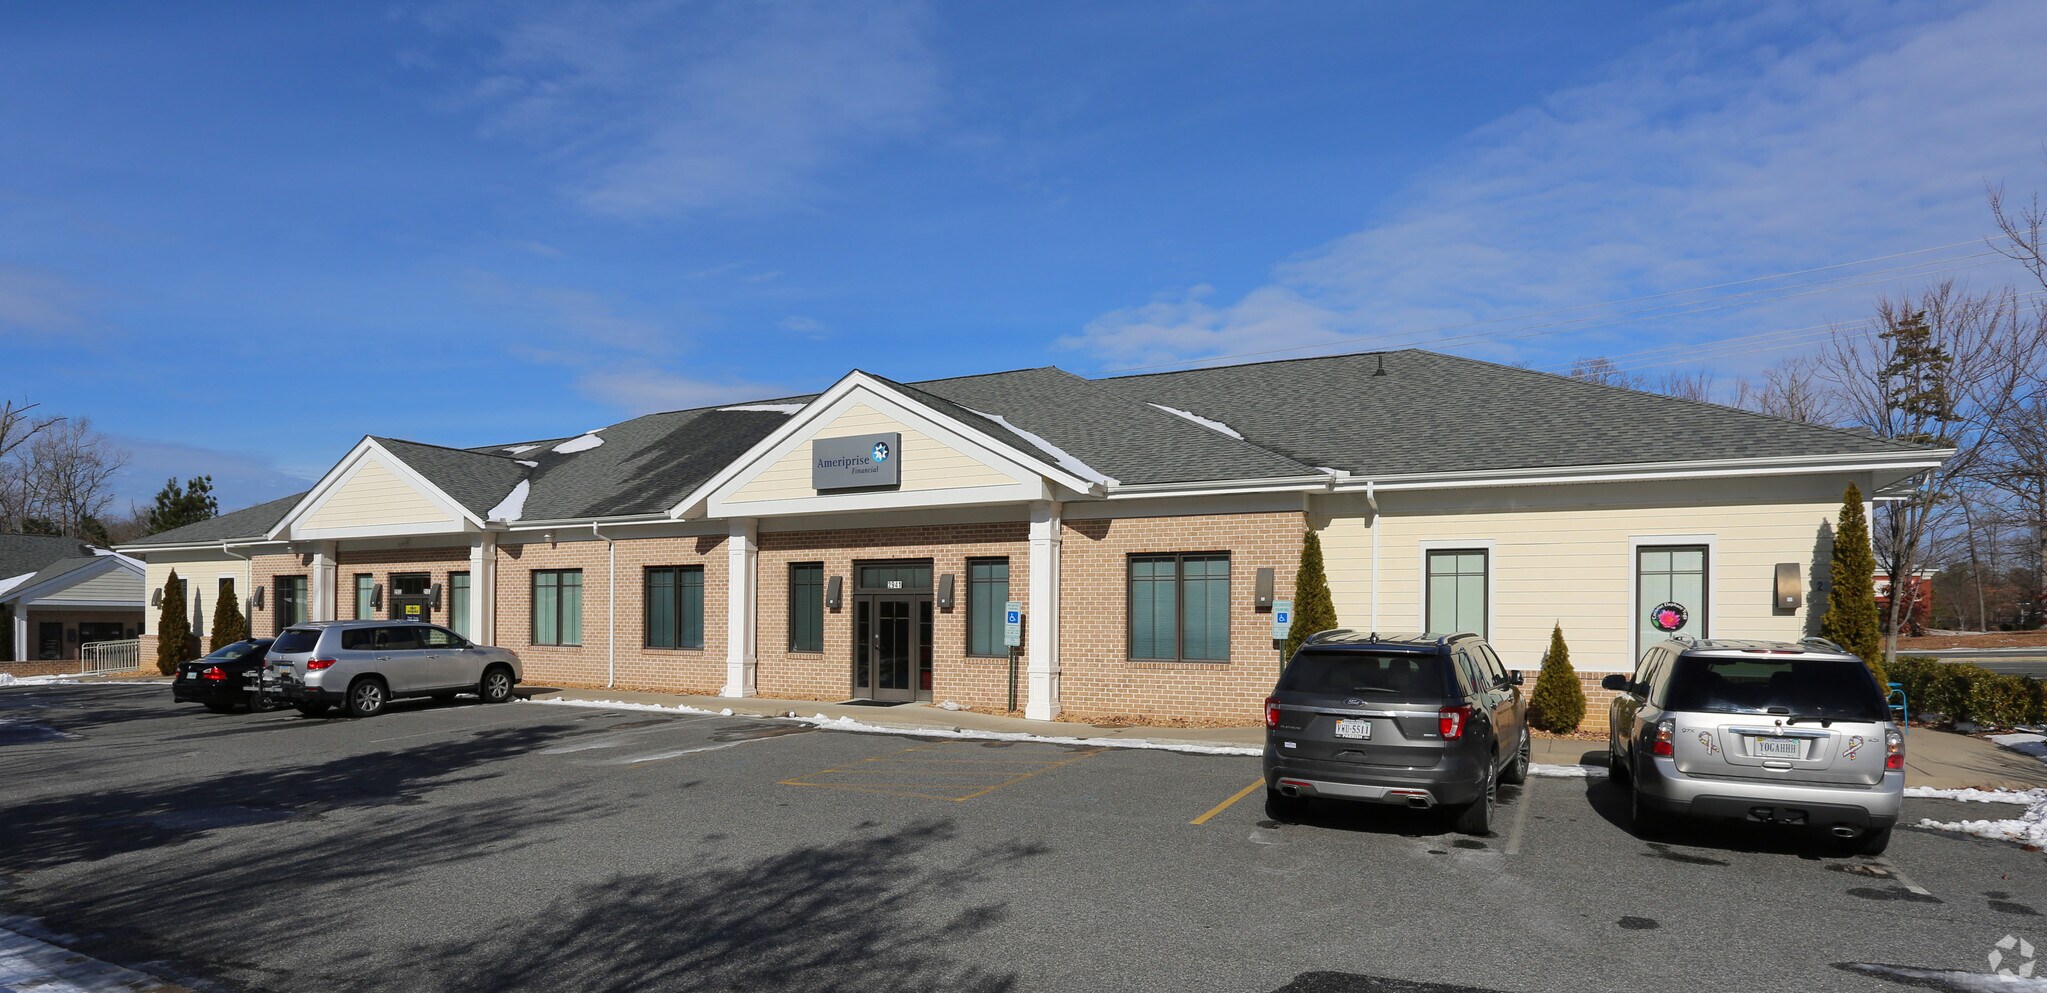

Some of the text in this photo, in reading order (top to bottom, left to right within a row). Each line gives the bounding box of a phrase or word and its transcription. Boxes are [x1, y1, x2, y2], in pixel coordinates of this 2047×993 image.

[817, 455, 870, 469] Ameriprise
[851, 465, 879, 475] Financial
[1759, 742, 1796, 754] YOGAHHH
